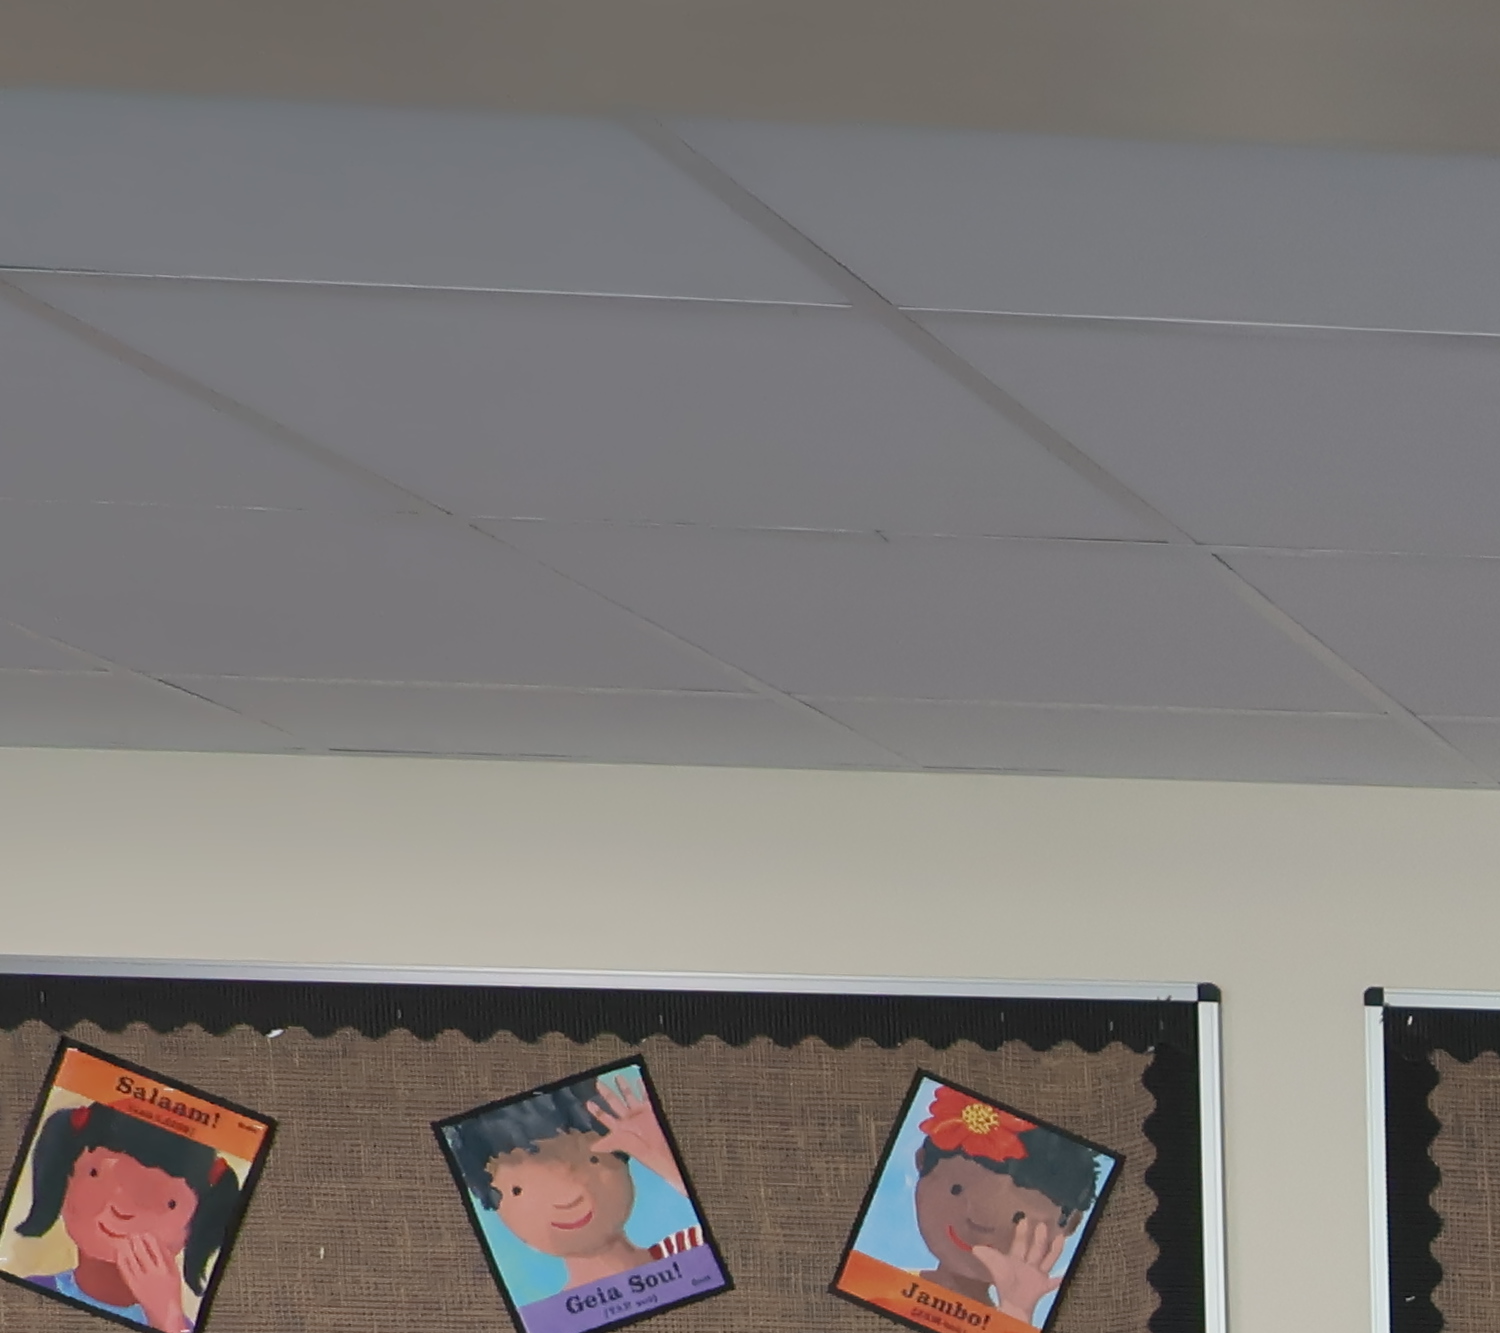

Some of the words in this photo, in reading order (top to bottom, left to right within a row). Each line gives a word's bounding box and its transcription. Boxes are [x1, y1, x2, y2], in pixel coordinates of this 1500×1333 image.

[115, 1075, 221, 1129] Salaam!
[566, 1286, 623, 1315] Geia
[628, 1261, 682, 1293] Sou!
[902, 1282, 992, 1330] Jambo!
